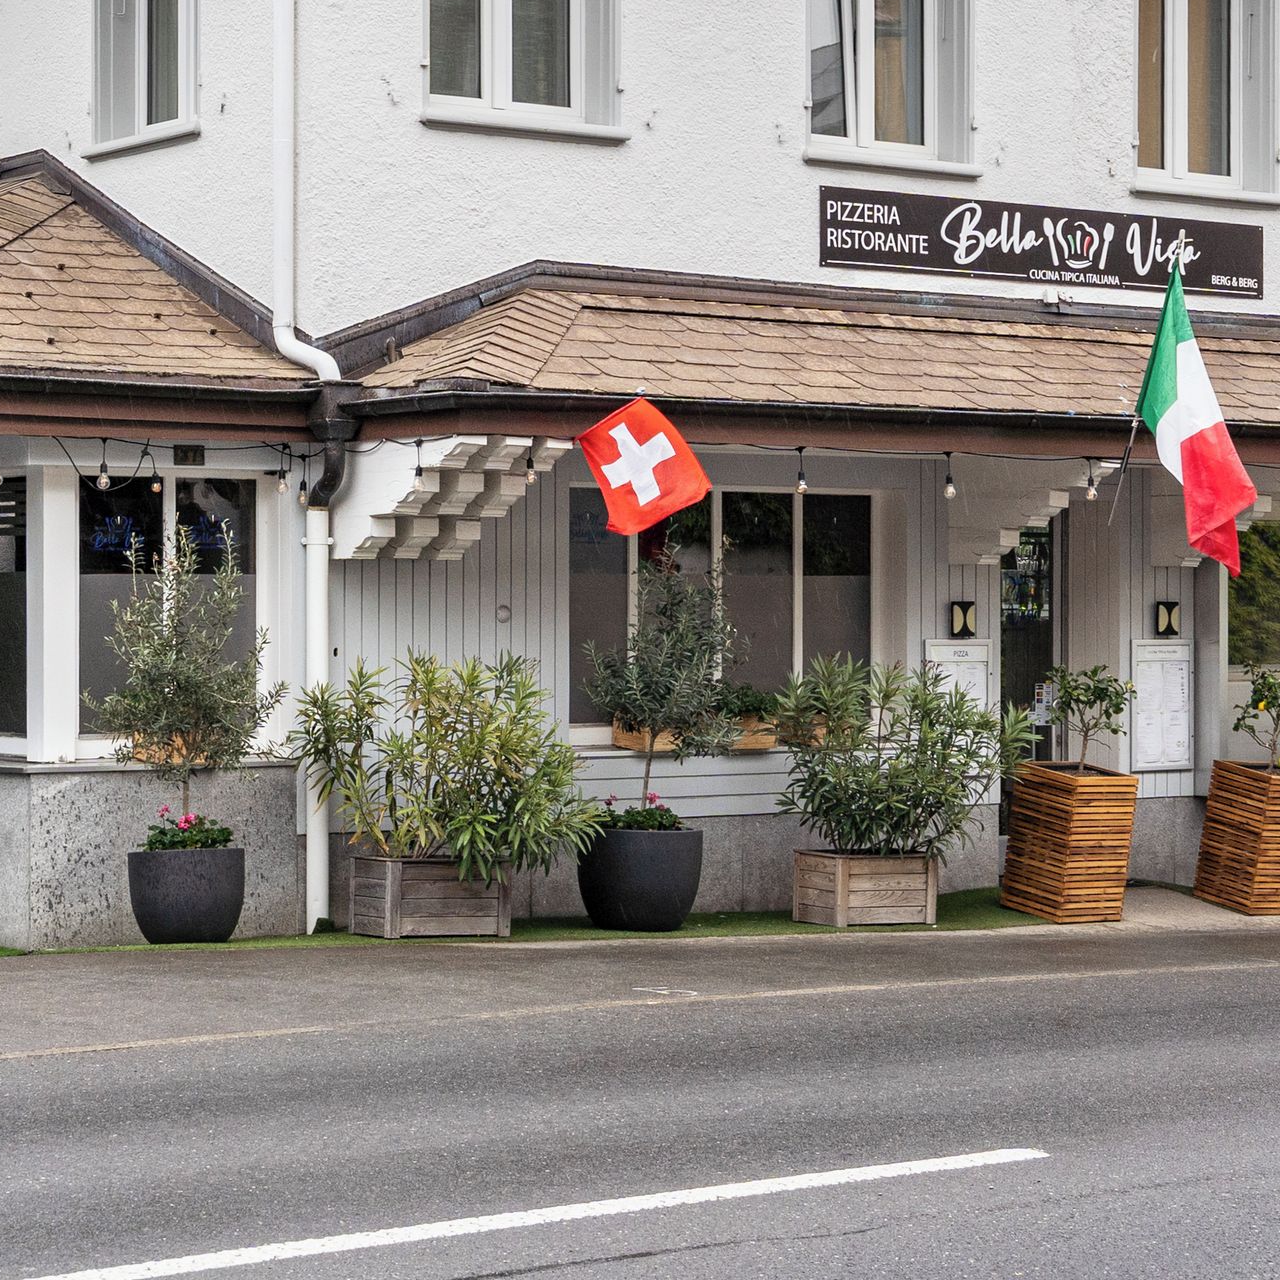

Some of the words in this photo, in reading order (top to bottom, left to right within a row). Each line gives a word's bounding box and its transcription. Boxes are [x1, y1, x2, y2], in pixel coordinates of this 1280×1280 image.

[826, 200, 901, 226] PIZZERIA
[826, 228, 929, 255] RISTORANTE
[940, 202, 1043, 265] Bella
[1126, 218, 1201, 276] Vista
[1029, 269, 1060, 281] CUCINA
[1060, 271, 1085, 283] TIPICA
[1086, 273, 1120, 285] ITALIANA
[1211, 274, 1232, 287] BERG
[1232, 276, 1238, 286] &
[1238, 277, 1258, 288] BERG
[953, 650, 969, 658] PIZZA
